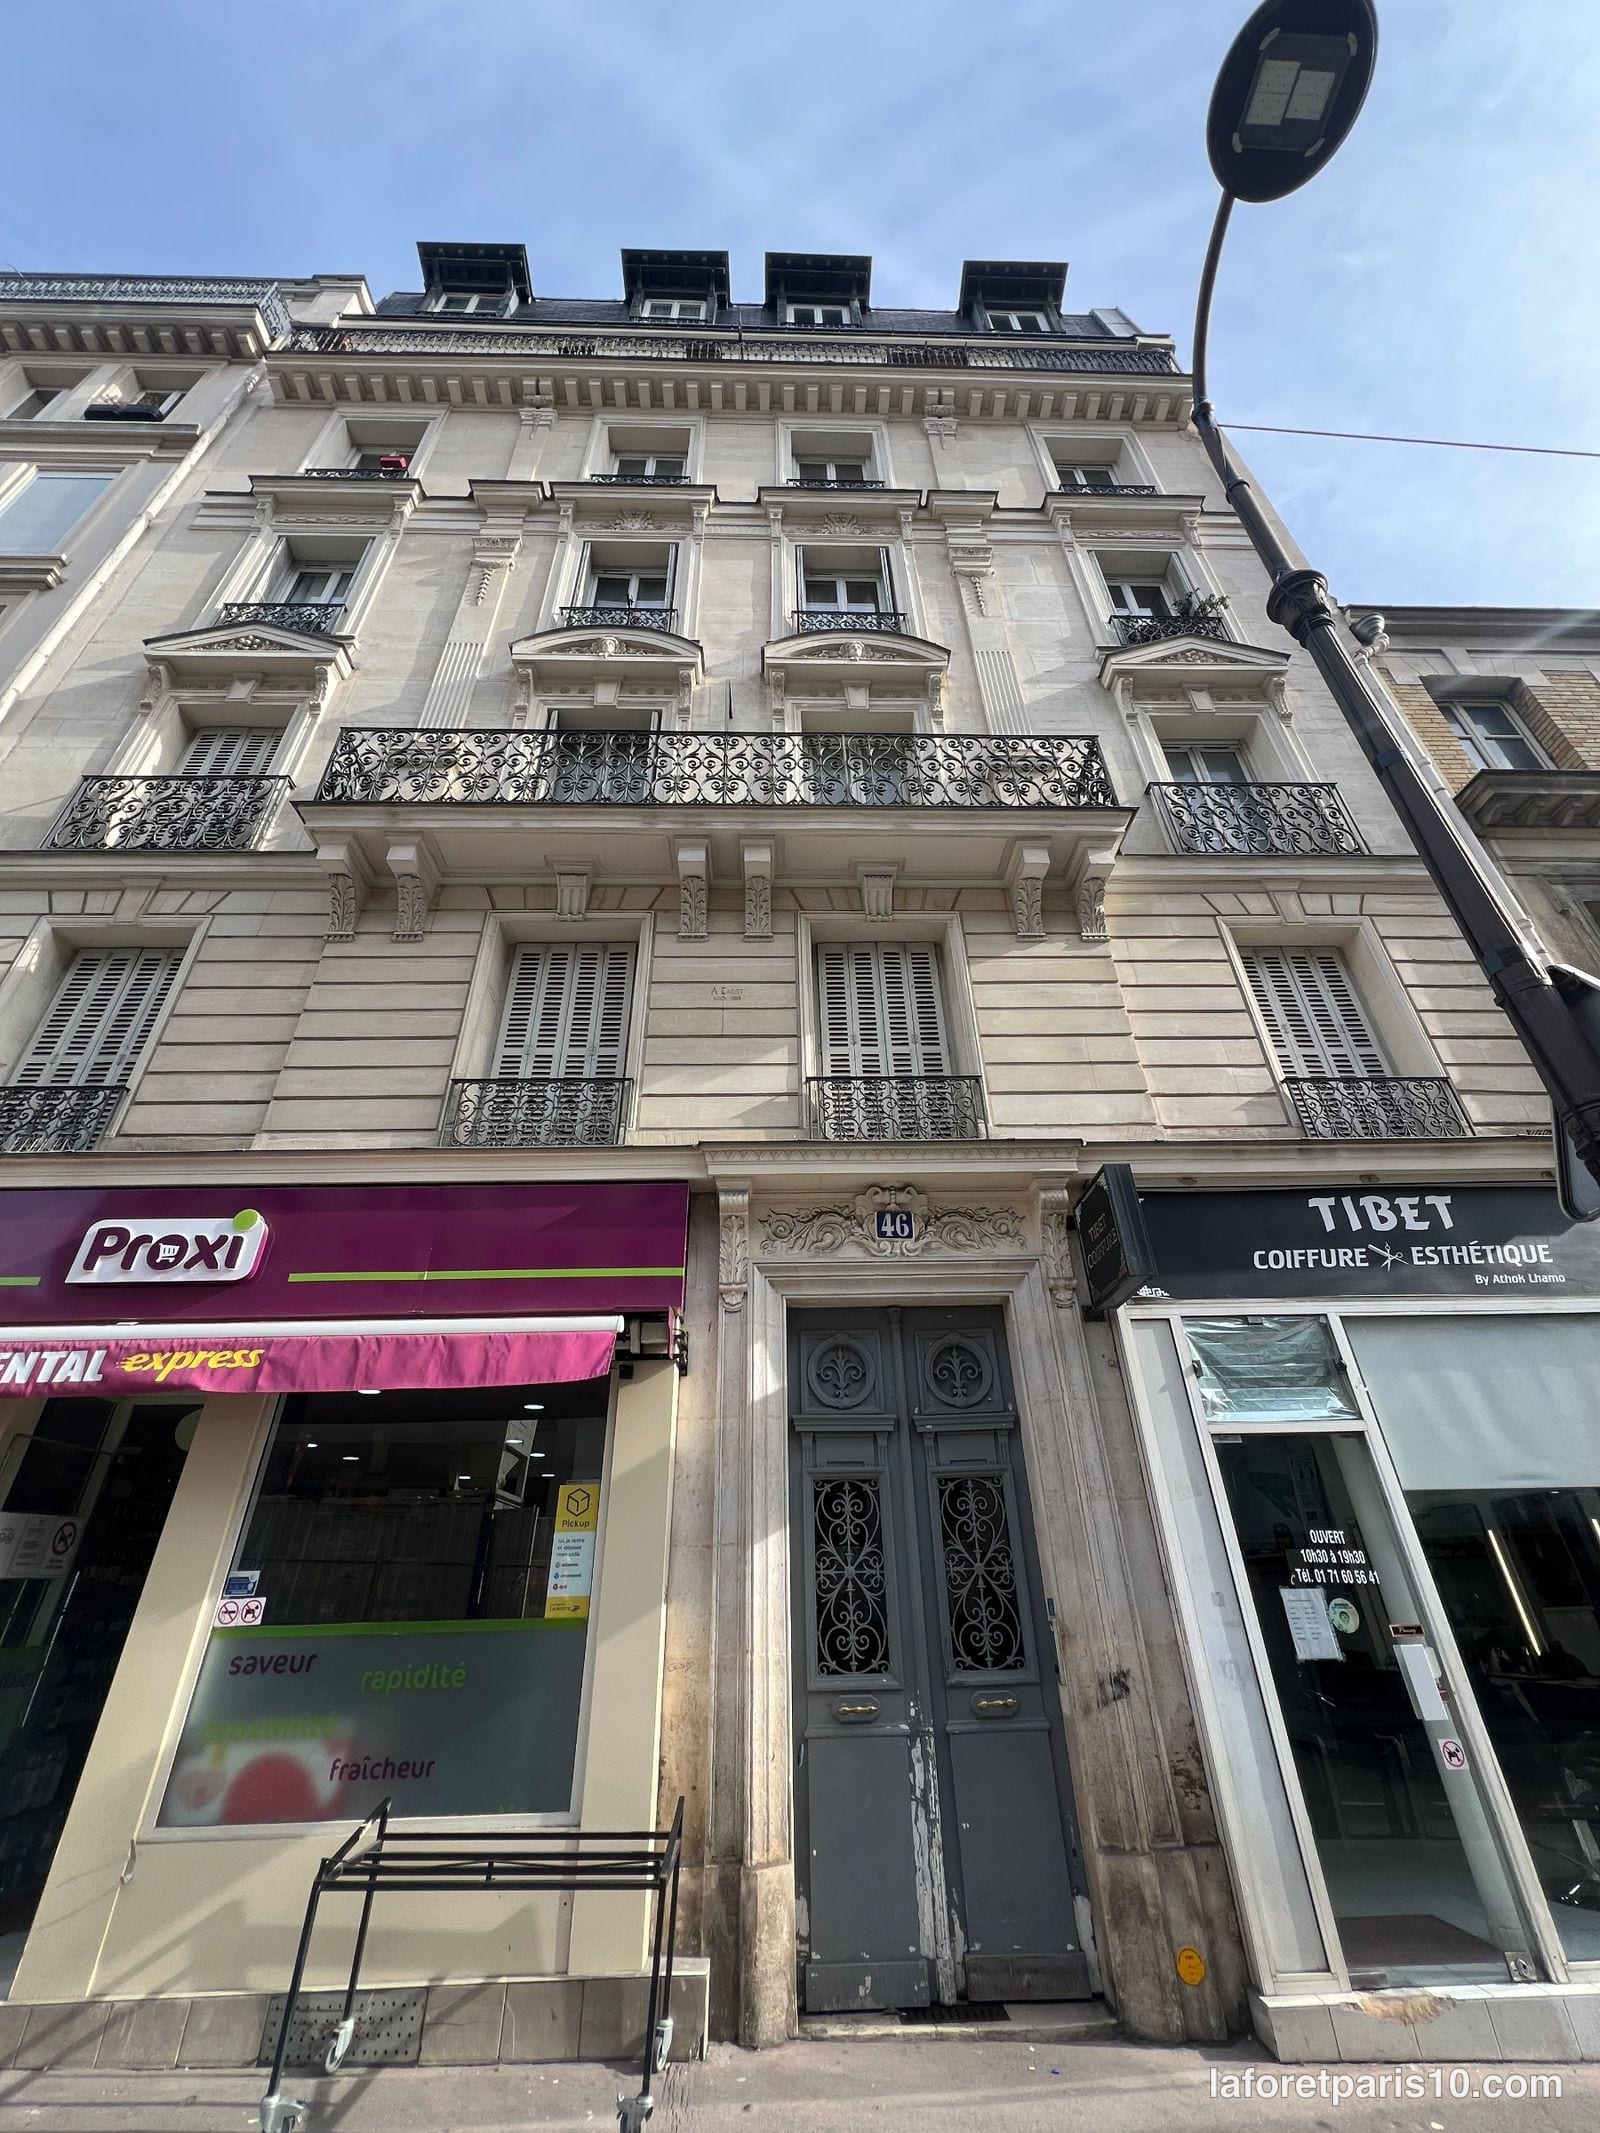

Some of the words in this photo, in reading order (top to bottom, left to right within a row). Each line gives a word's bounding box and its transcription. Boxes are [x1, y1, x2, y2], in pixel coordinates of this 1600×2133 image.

[880, 1213, 910, 1237] 46
[1308, 1195, 1454, 1232] TIBET
[82, 1209, 260, 1271] Proxi
[1088, 1213, 1107, 1242] TIBET
[1253, 1248, 1369, 1269] COIFFURE
[1410, 1240, 1554, 1267] ESTHÉTIQUE
[1475, 1274, 1489, 1286] By
[1493, 1273, 1525, 1284] Athok
[1528, 1273, 1565, 1284] Lhamo
[119, 1348, 265, 1382] express
[561, 1519, 590, 1529] Pickup
[1309, 1529, 1346, 1545] OUVERT
[1300, 1548, 1329, 1563] 10h30
[1329, 1549, 1337, 1563] à
[1337, 1549, 1366, 1564] 19h30
[1295, 1568, 1314, 1583] Tél.
[1314, 1568, 1326, 1583] 01
[1327, 1569, 1340, 1583] 71
[1341, 1569, 1354, 1584] 60
[1354, 1570, 1367, 1585] 56
[1368, 1570, 1380, 1585] 41
[228, 1653, 318, 1677] saveur
[360, 1661, 467, 1695] rapidité
[329, 1755, 436, 1782] fraîcheur
